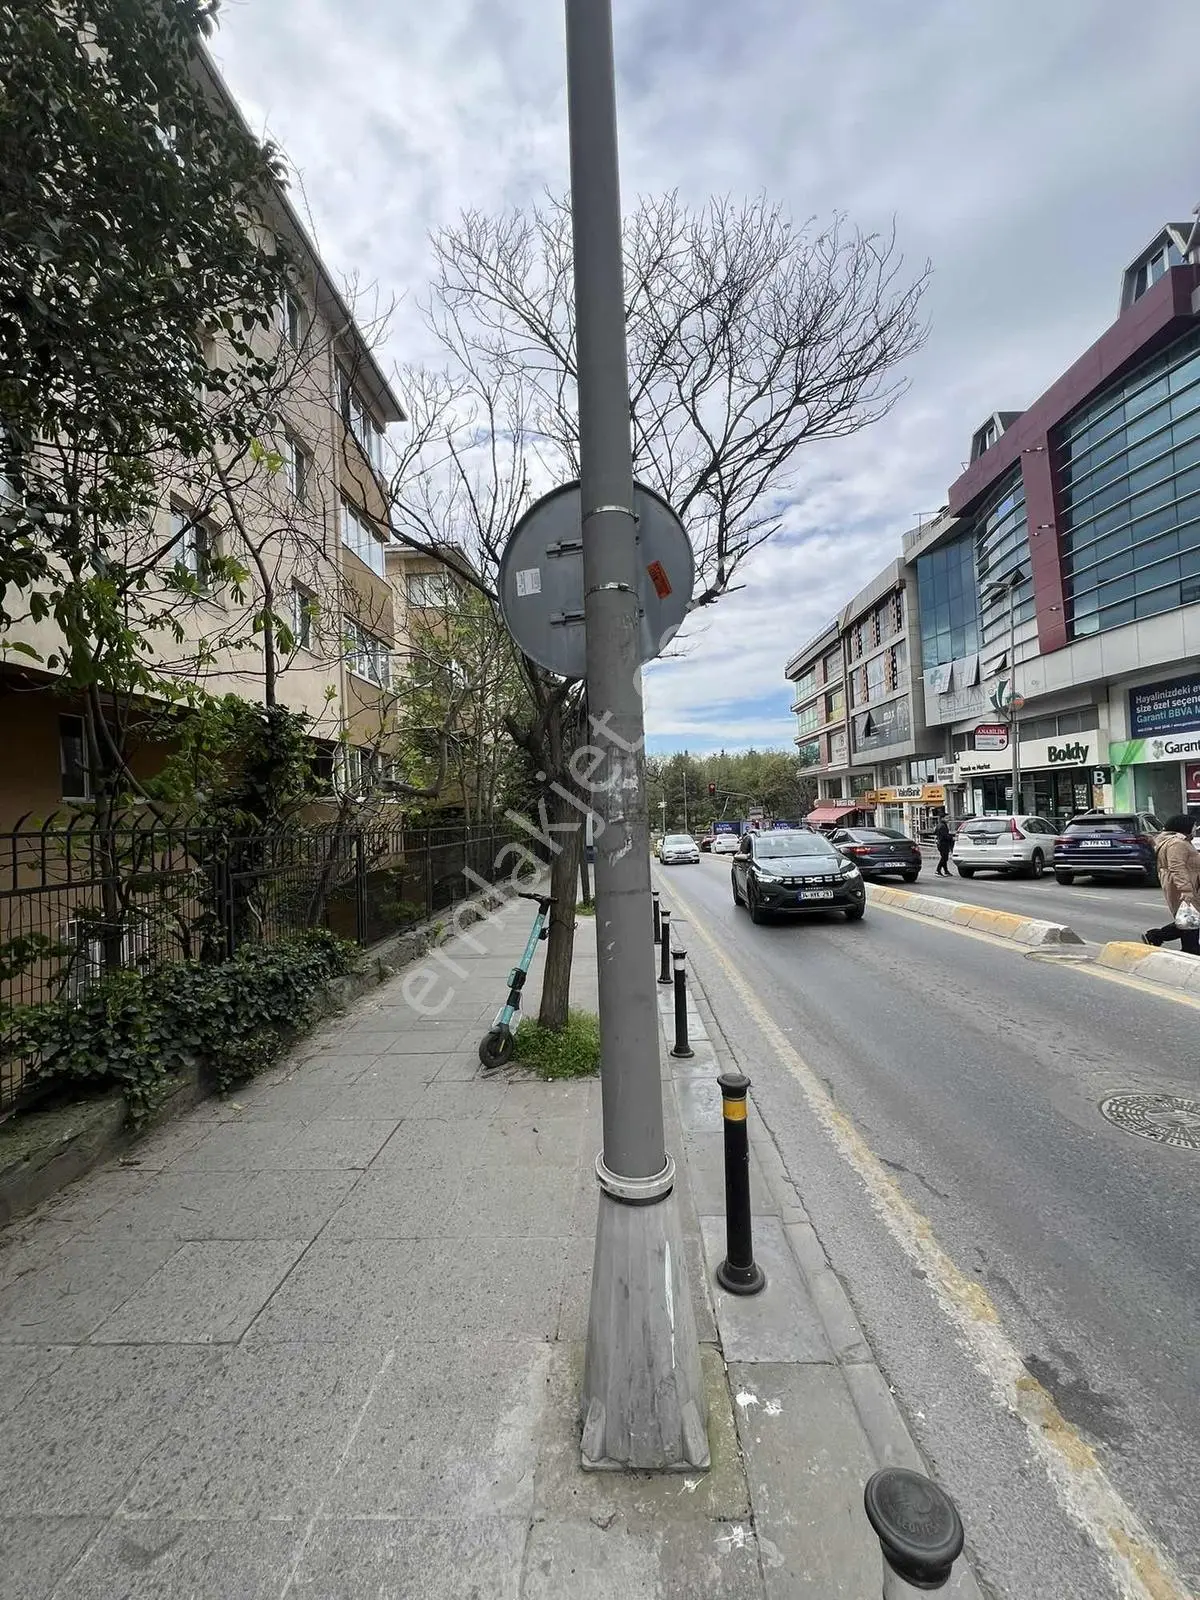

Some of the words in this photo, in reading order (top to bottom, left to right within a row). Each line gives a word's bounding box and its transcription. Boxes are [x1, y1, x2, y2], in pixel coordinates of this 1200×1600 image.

[1135, 684, 1191, 704] Hayalinizdeki
[1136, 704, 1152, 714] size
[1153, 699, 1170, 711] özel
[1136, 710, 1167, 723] Garanti
[1168, 706, 1192, 719] BBVA
[1048, 742, 1089, 764] Boldy
[1093, 771, 1106, 785] B
